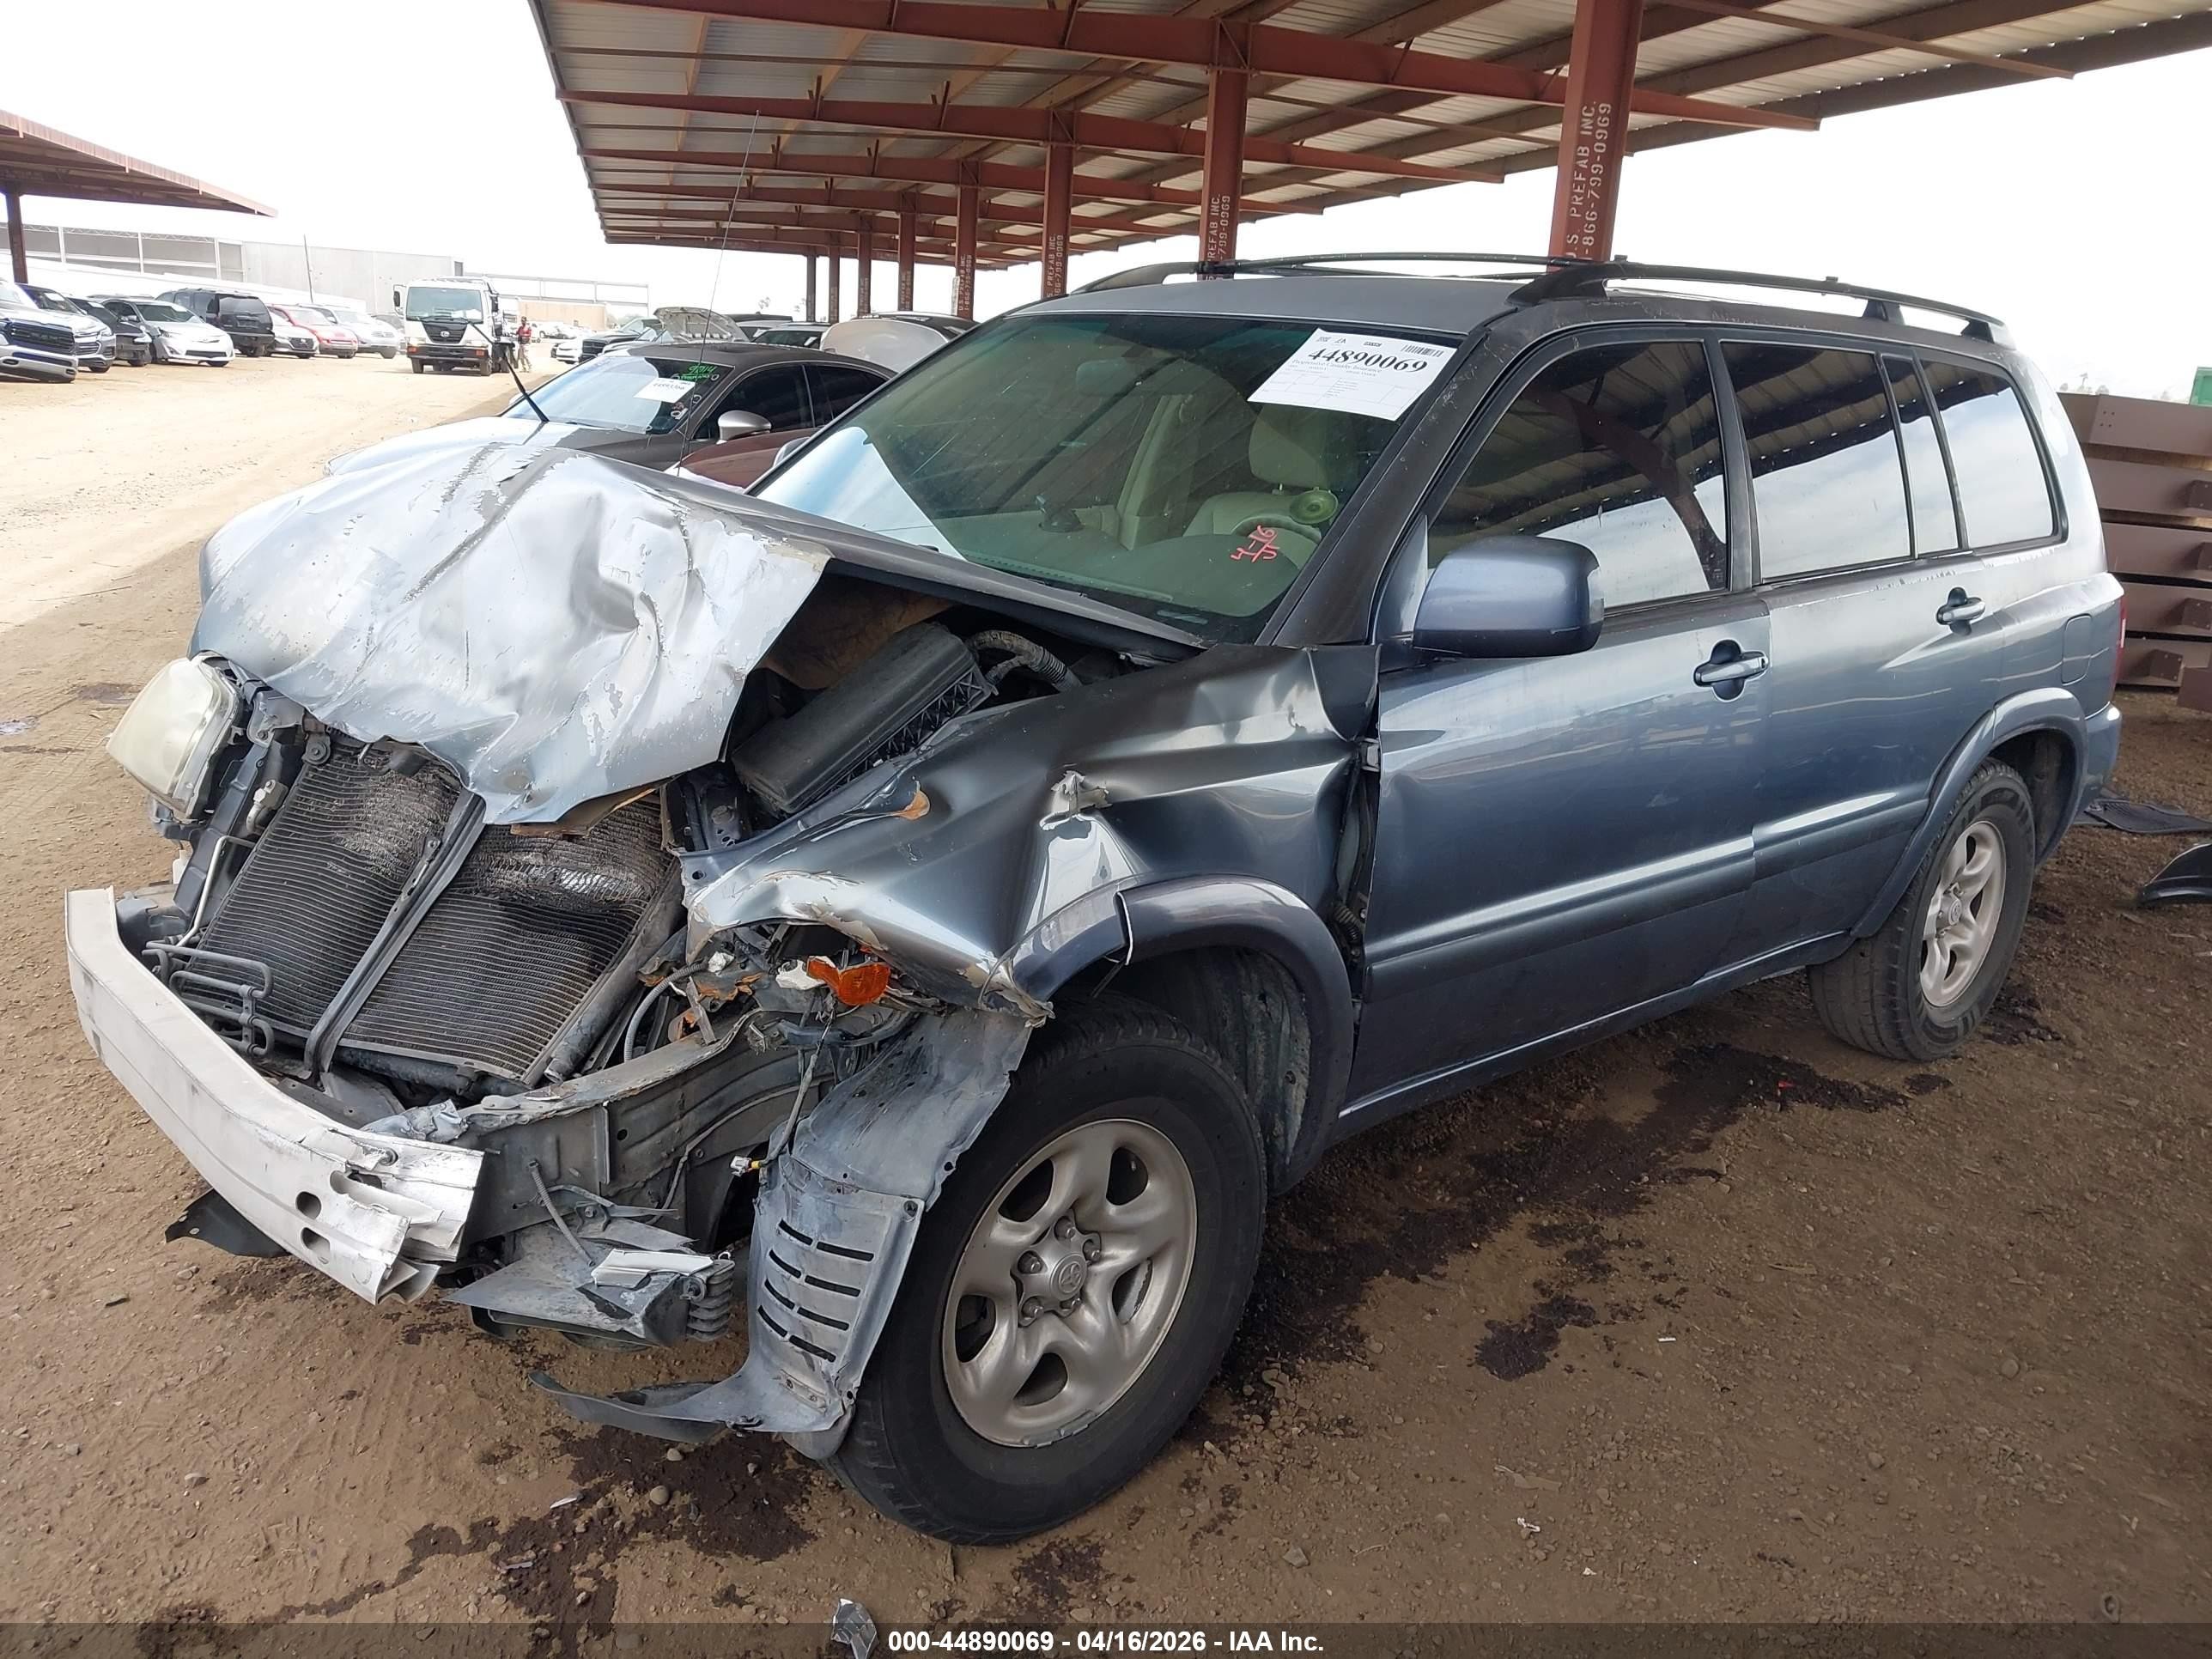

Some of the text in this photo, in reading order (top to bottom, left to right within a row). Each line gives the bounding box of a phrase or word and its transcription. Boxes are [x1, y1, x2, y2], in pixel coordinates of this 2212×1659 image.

[1570, 146, 1590, 217] PREFAB
[1580, 101, 1596, 136] INC.
[1210, 194, 1221, 216] INC.
[1207, 222, 1218, 262] REFAB
[1308, 349, 1428, 373] 44890069
